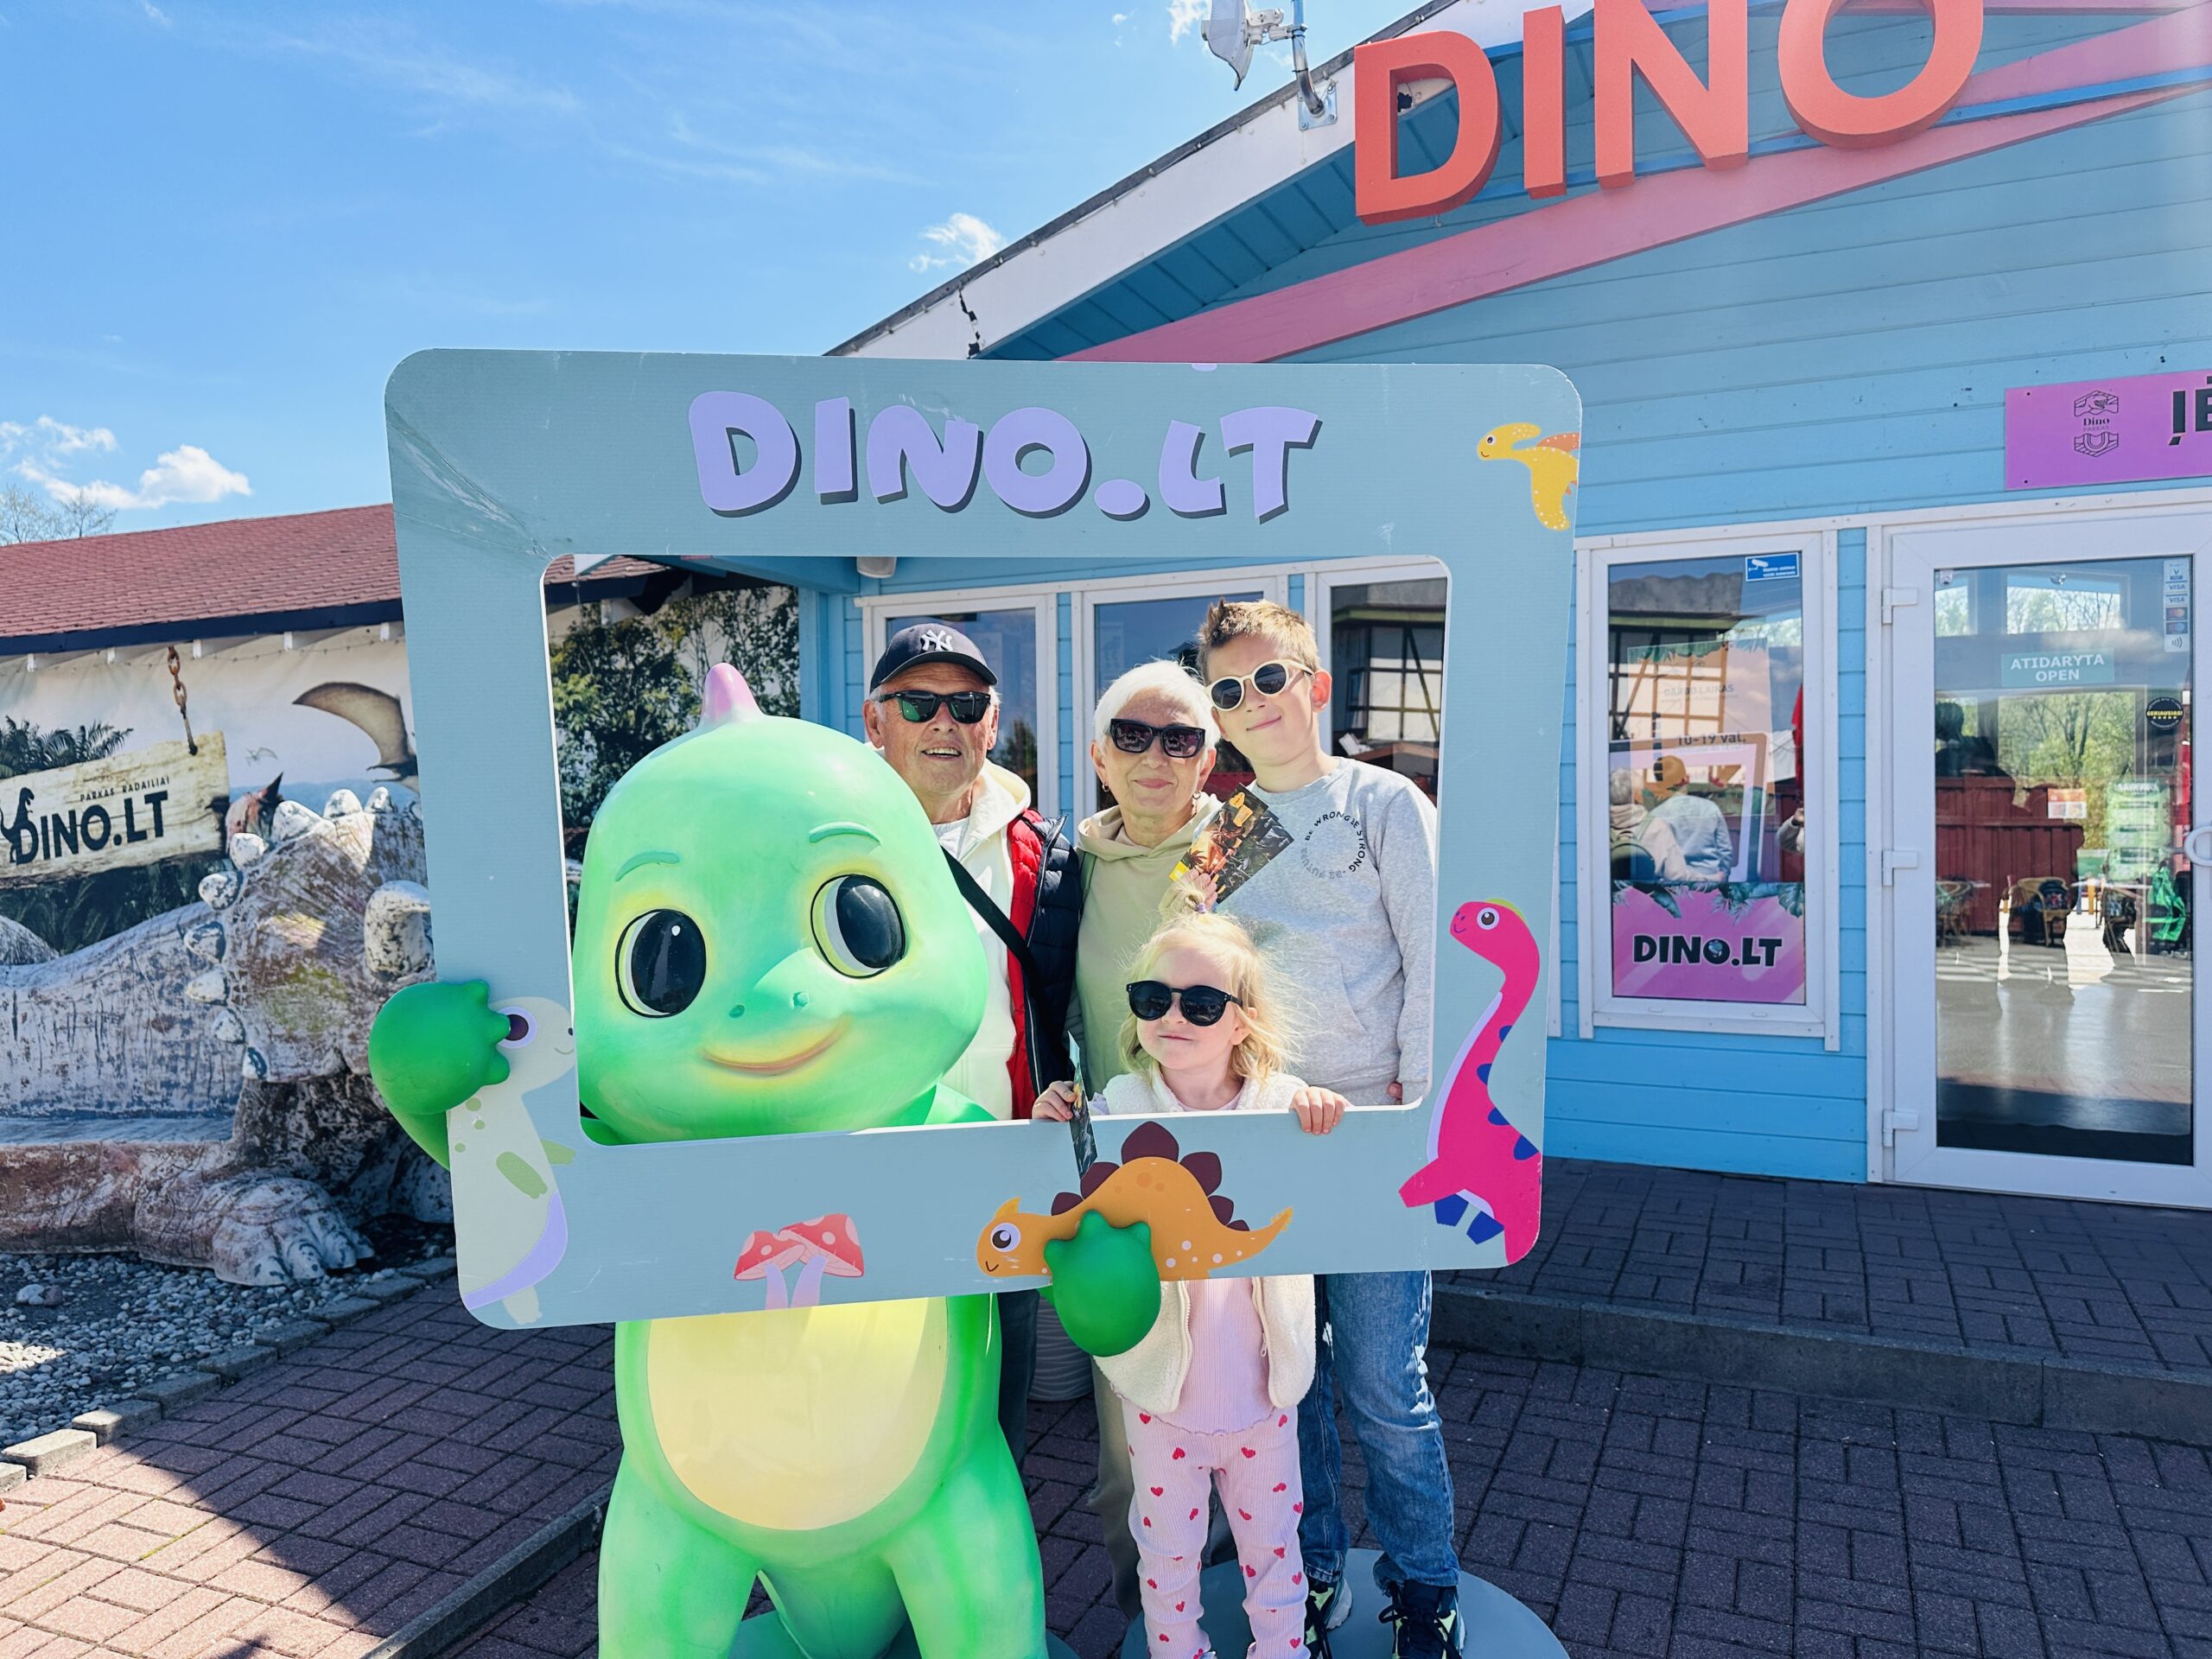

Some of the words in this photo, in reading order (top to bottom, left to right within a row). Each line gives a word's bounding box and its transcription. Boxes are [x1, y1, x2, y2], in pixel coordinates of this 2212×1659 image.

[1354, 0, 1985, 226] DINO
[2083, 416, 2110, 427] Dino
[689, 391, 1323, 524] DINO.LT
[921, 629, 953, 651] NY
[2011, 653, 2105, 670] ATIDARYTA
[2036, 669, 2080, 682] OPEN
[1719, 731, 1746, 744] val.
[80, 787, 115, 803] PARKAS
[122, 775, 170, 793] RADAILIAI
[11, 790, 168, 866] DINO.LT
[1313, 811, 1351, 827] WRONG
[1632, 934, 1783, 967] DINO.LT
